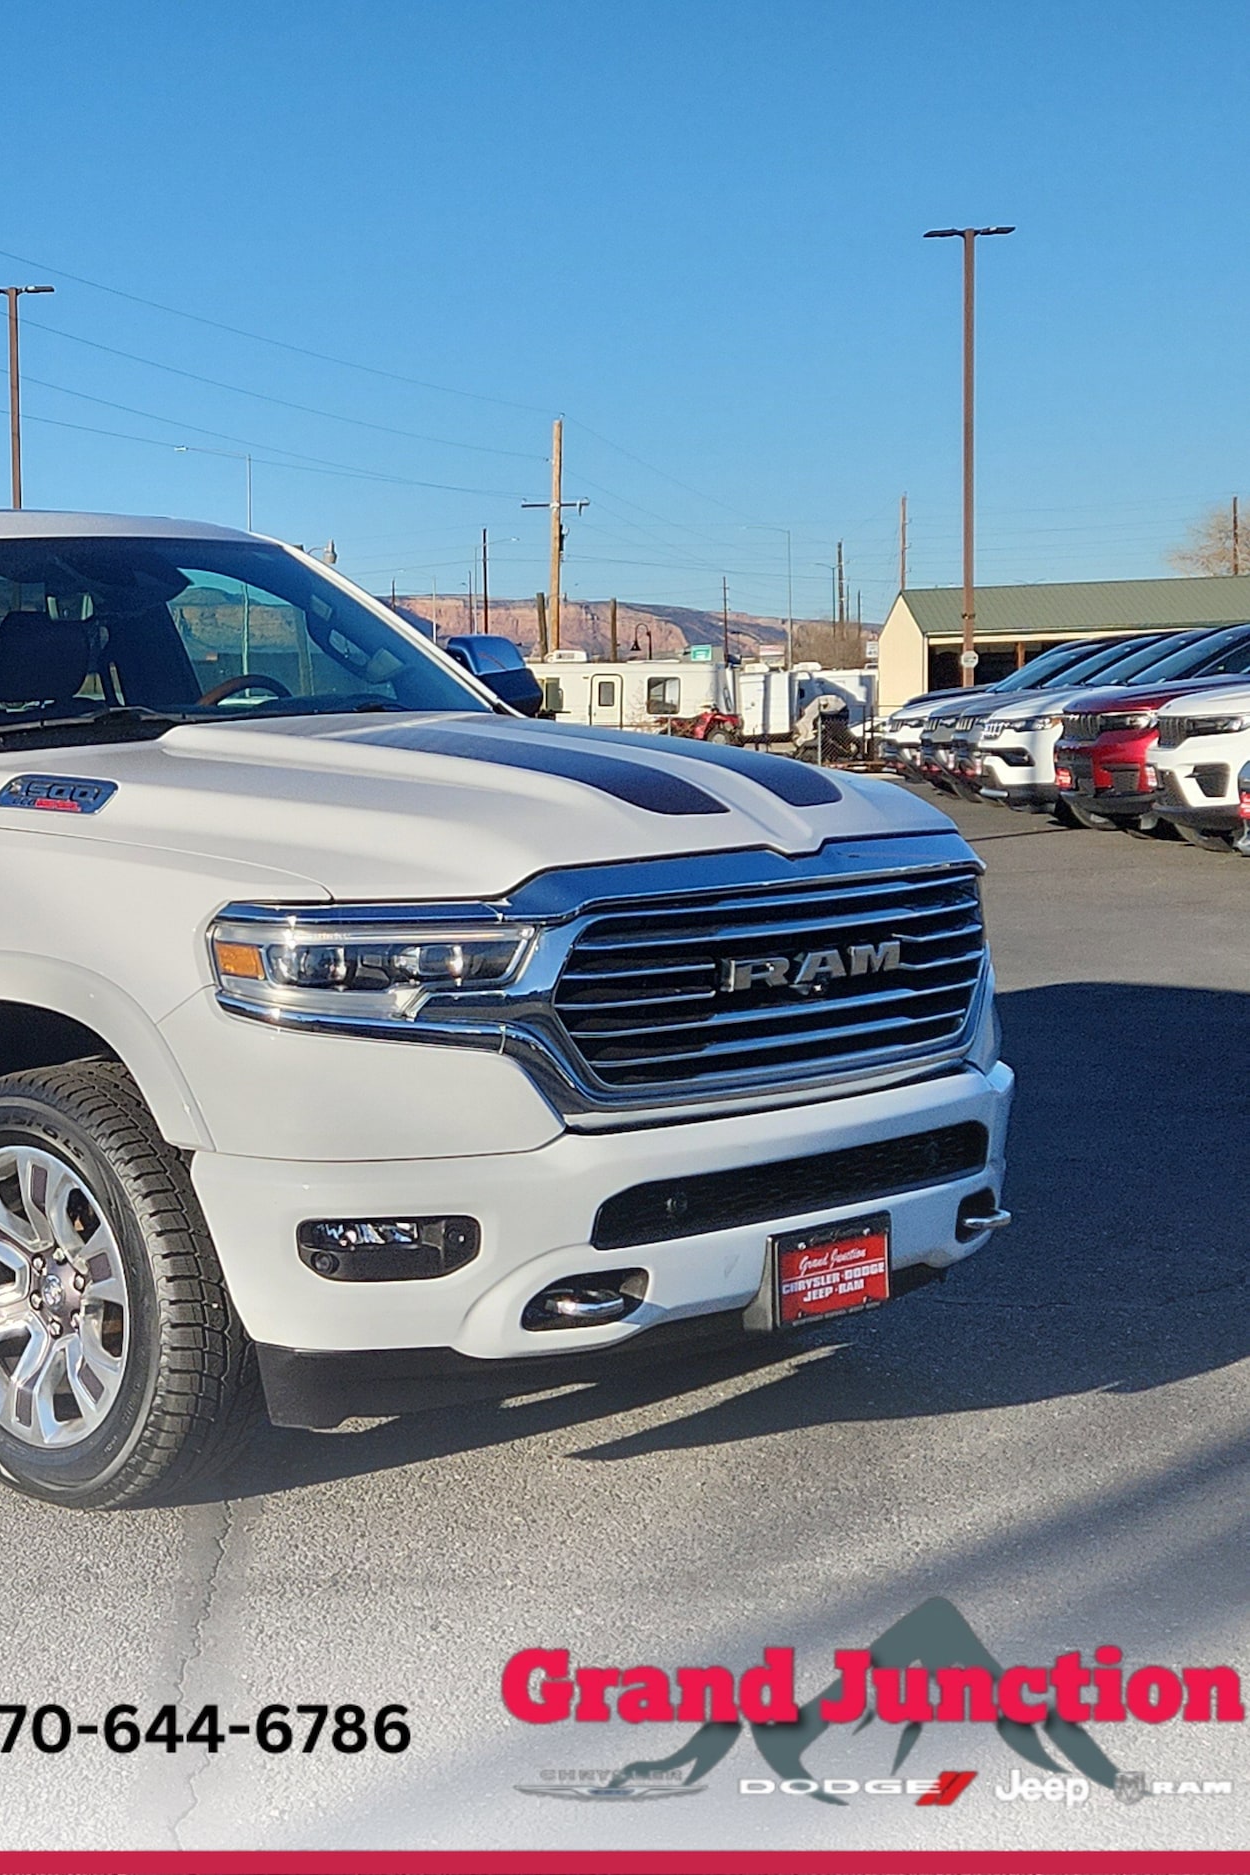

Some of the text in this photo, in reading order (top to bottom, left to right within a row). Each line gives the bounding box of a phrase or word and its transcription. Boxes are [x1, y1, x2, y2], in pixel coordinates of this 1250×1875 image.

[722, 941, 900, 993] RAM
[782, 1261, 885, 1295] CHRYSLER DODGE
[803, 1278, 865, 1303] JEEP RAM
